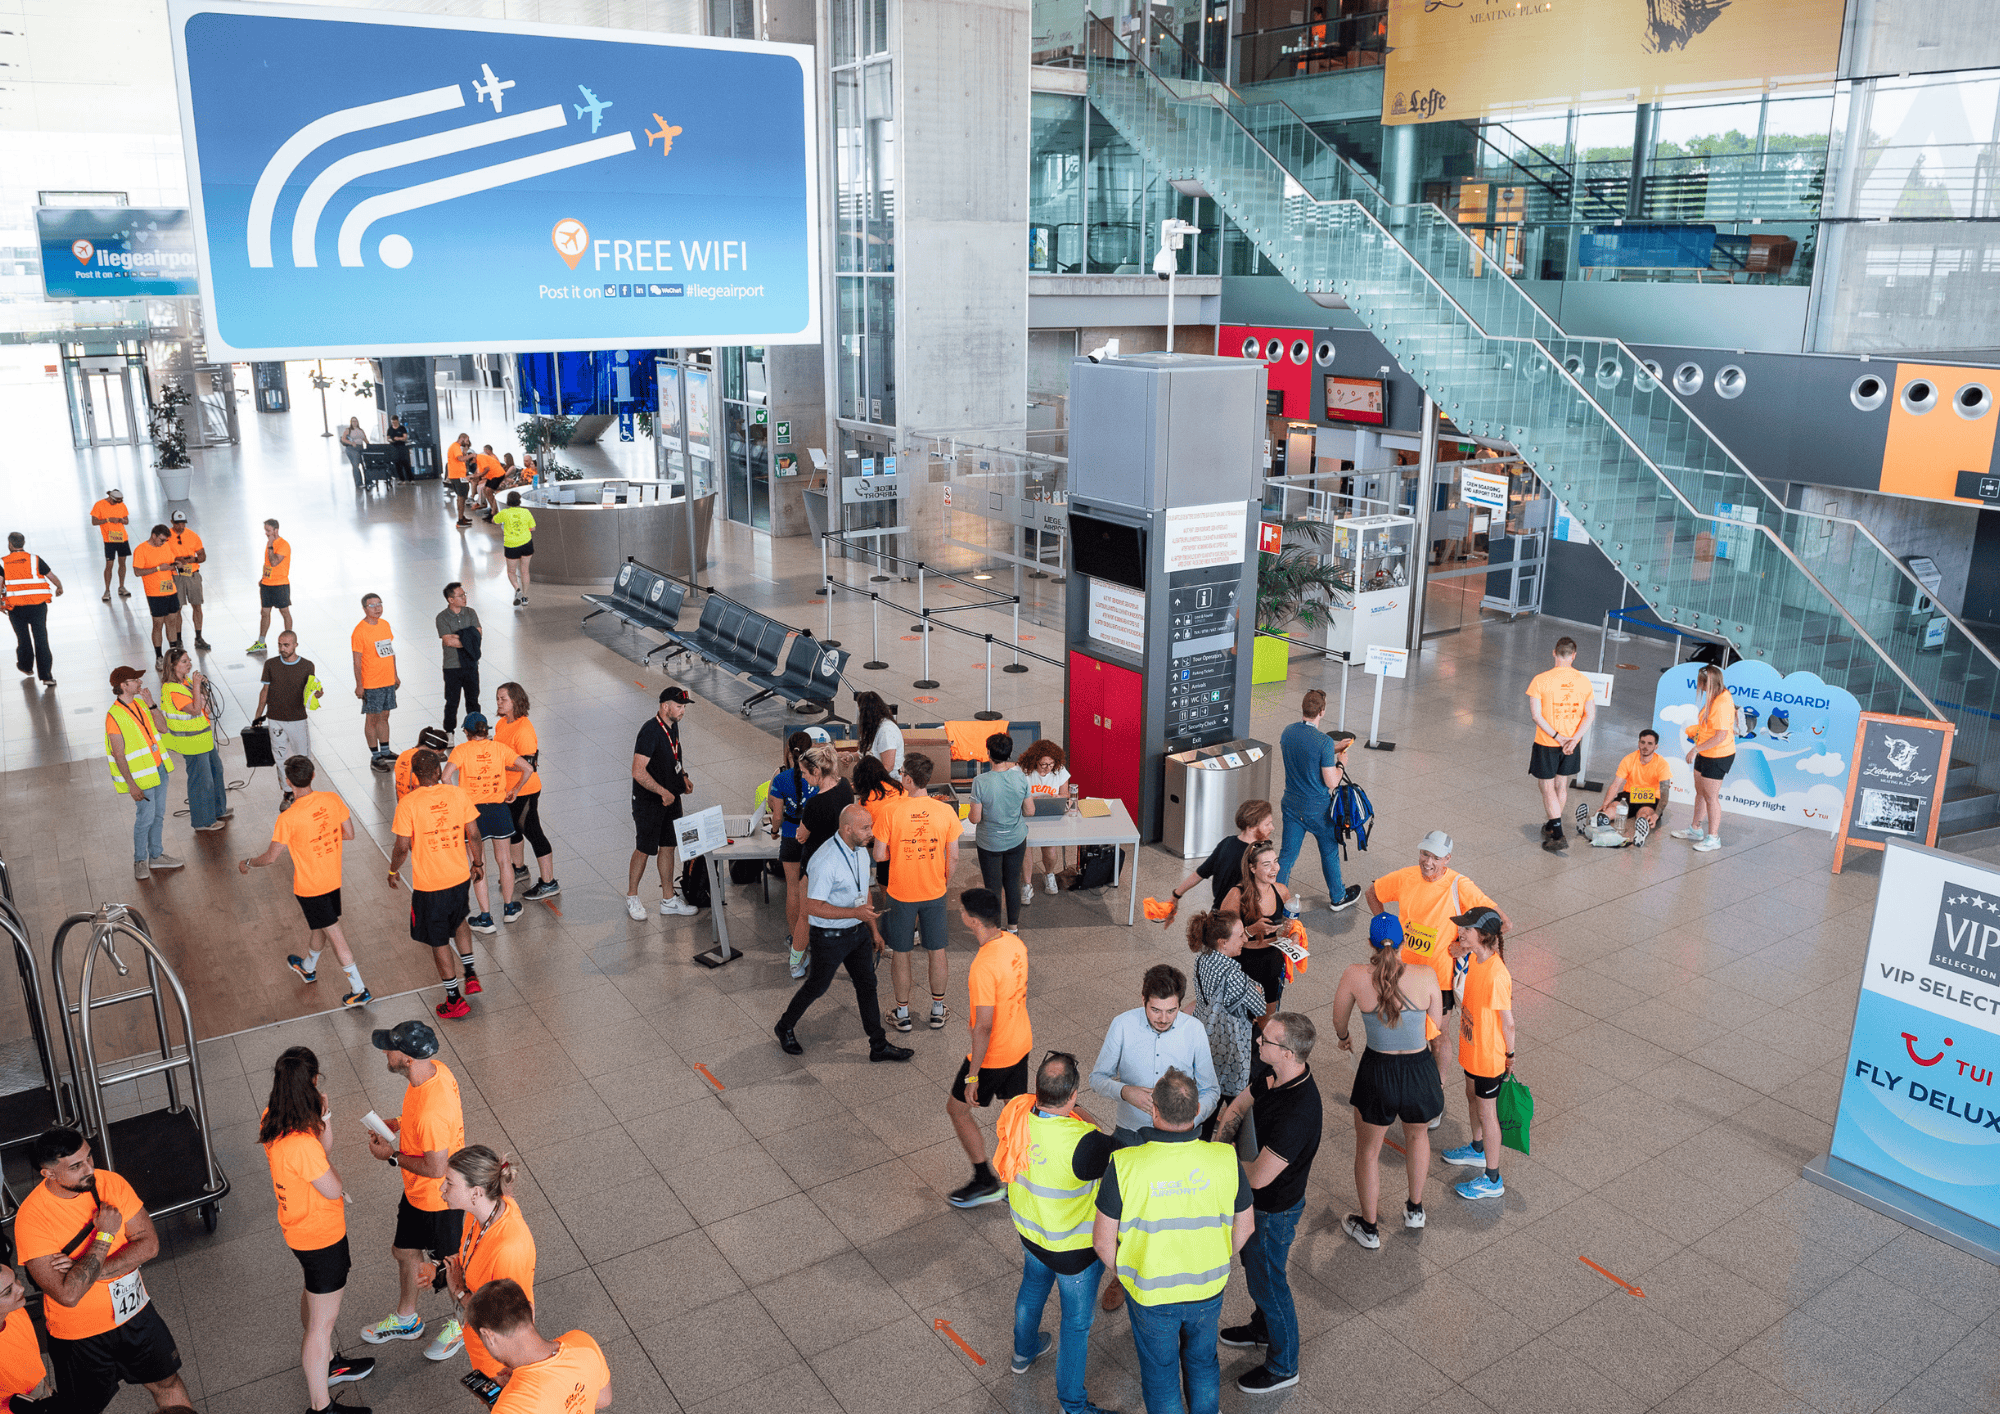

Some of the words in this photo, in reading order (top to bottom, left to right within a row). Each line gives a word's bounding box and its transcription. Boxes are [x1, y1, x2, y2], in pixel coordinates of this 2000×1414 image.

[1469, 10, 1516, 25] MEATING
[1408, 88, 1446, 118] Leffe
[593, 239, 673, 271] FREE
[679, 240, 747, 271] WIFI
[75, 271, 93, 279] Post
[539, 284, 569, 299] Post
[571, 284, 582, 298] it
[583, 287, 601, 299] on
[686, 284, 765, 300] #liegeairport
[1466, 480, 1478, 488] CREW
[1478, 484, 1501, 493] BOARDING
[1473, 488, 1490, 497] AIRPORT
[1043, 515, 1062, 526] LIEGE
[1202, 653, 1223, 661] Operators
[1191, 682, 1207, 690] Arrivals
[1191, 695, 1200, 704] WC
[1686, 678, 1760, 699] WOME
[1763, 690, 1830, 710] ABOARD!
[1188, 723, 1204, 731] Security
[1204, 719, 1217, 727] Check
[1192, 736, 1202, 744] Exit
[1632, 792, 1654, 800] 7082
[1732, 795, 1760, 808] happy
[1762, 800, 1786, 812] flight
[1404, 932, 1431, 953] 7099
[1944, 912, 2000, 961] VIP
[1934, 954, 1997, 980] SELECTION
[1879, 962, 1915, 985] VIP
[1919, 976, 2000, 1016] SELECT
[1955, 1059, 1994, 1087] TUI
[1854, 1059, 1903, 1092] FLY
[1908, 1080, 2000, 1134] DELUX
[1150, 1180, 1183, 1190] LIEGE
[1150, 1187, 1197, 1198] AIRPORT
[379, 1328, 410, 1339] NITRO
